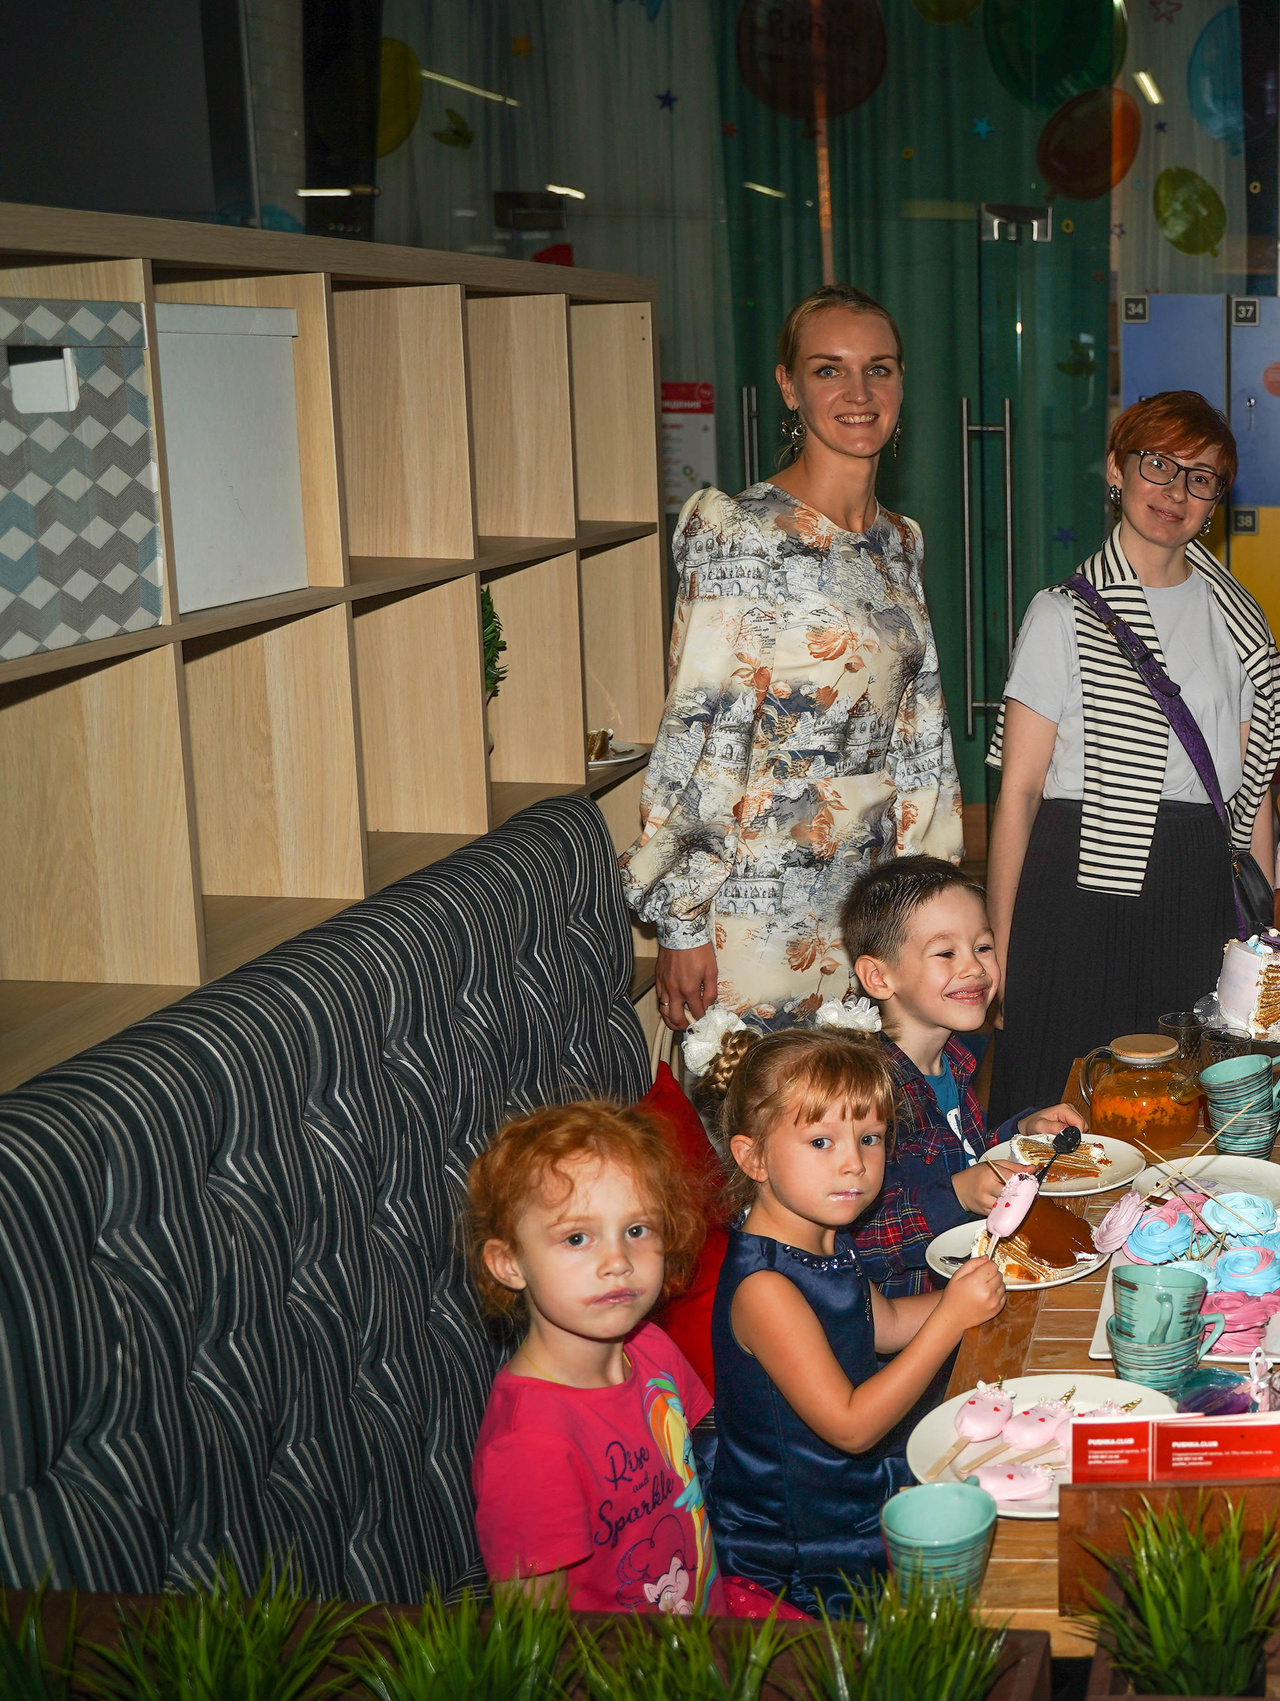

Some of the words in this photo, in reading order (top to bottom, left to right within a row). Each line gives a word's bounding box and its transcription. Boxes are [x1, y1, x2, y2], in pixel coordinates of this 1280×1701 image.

[1126, 303, 1145, 316] 34
[1236, 305, 1255, 319] 37
[1237, 514, 1254, 528] 38
[604, 1440, 650, 1492] Rise
[632, 1470, 650, 1494] and
[594, 1469, 674, 1550] Sparkle
